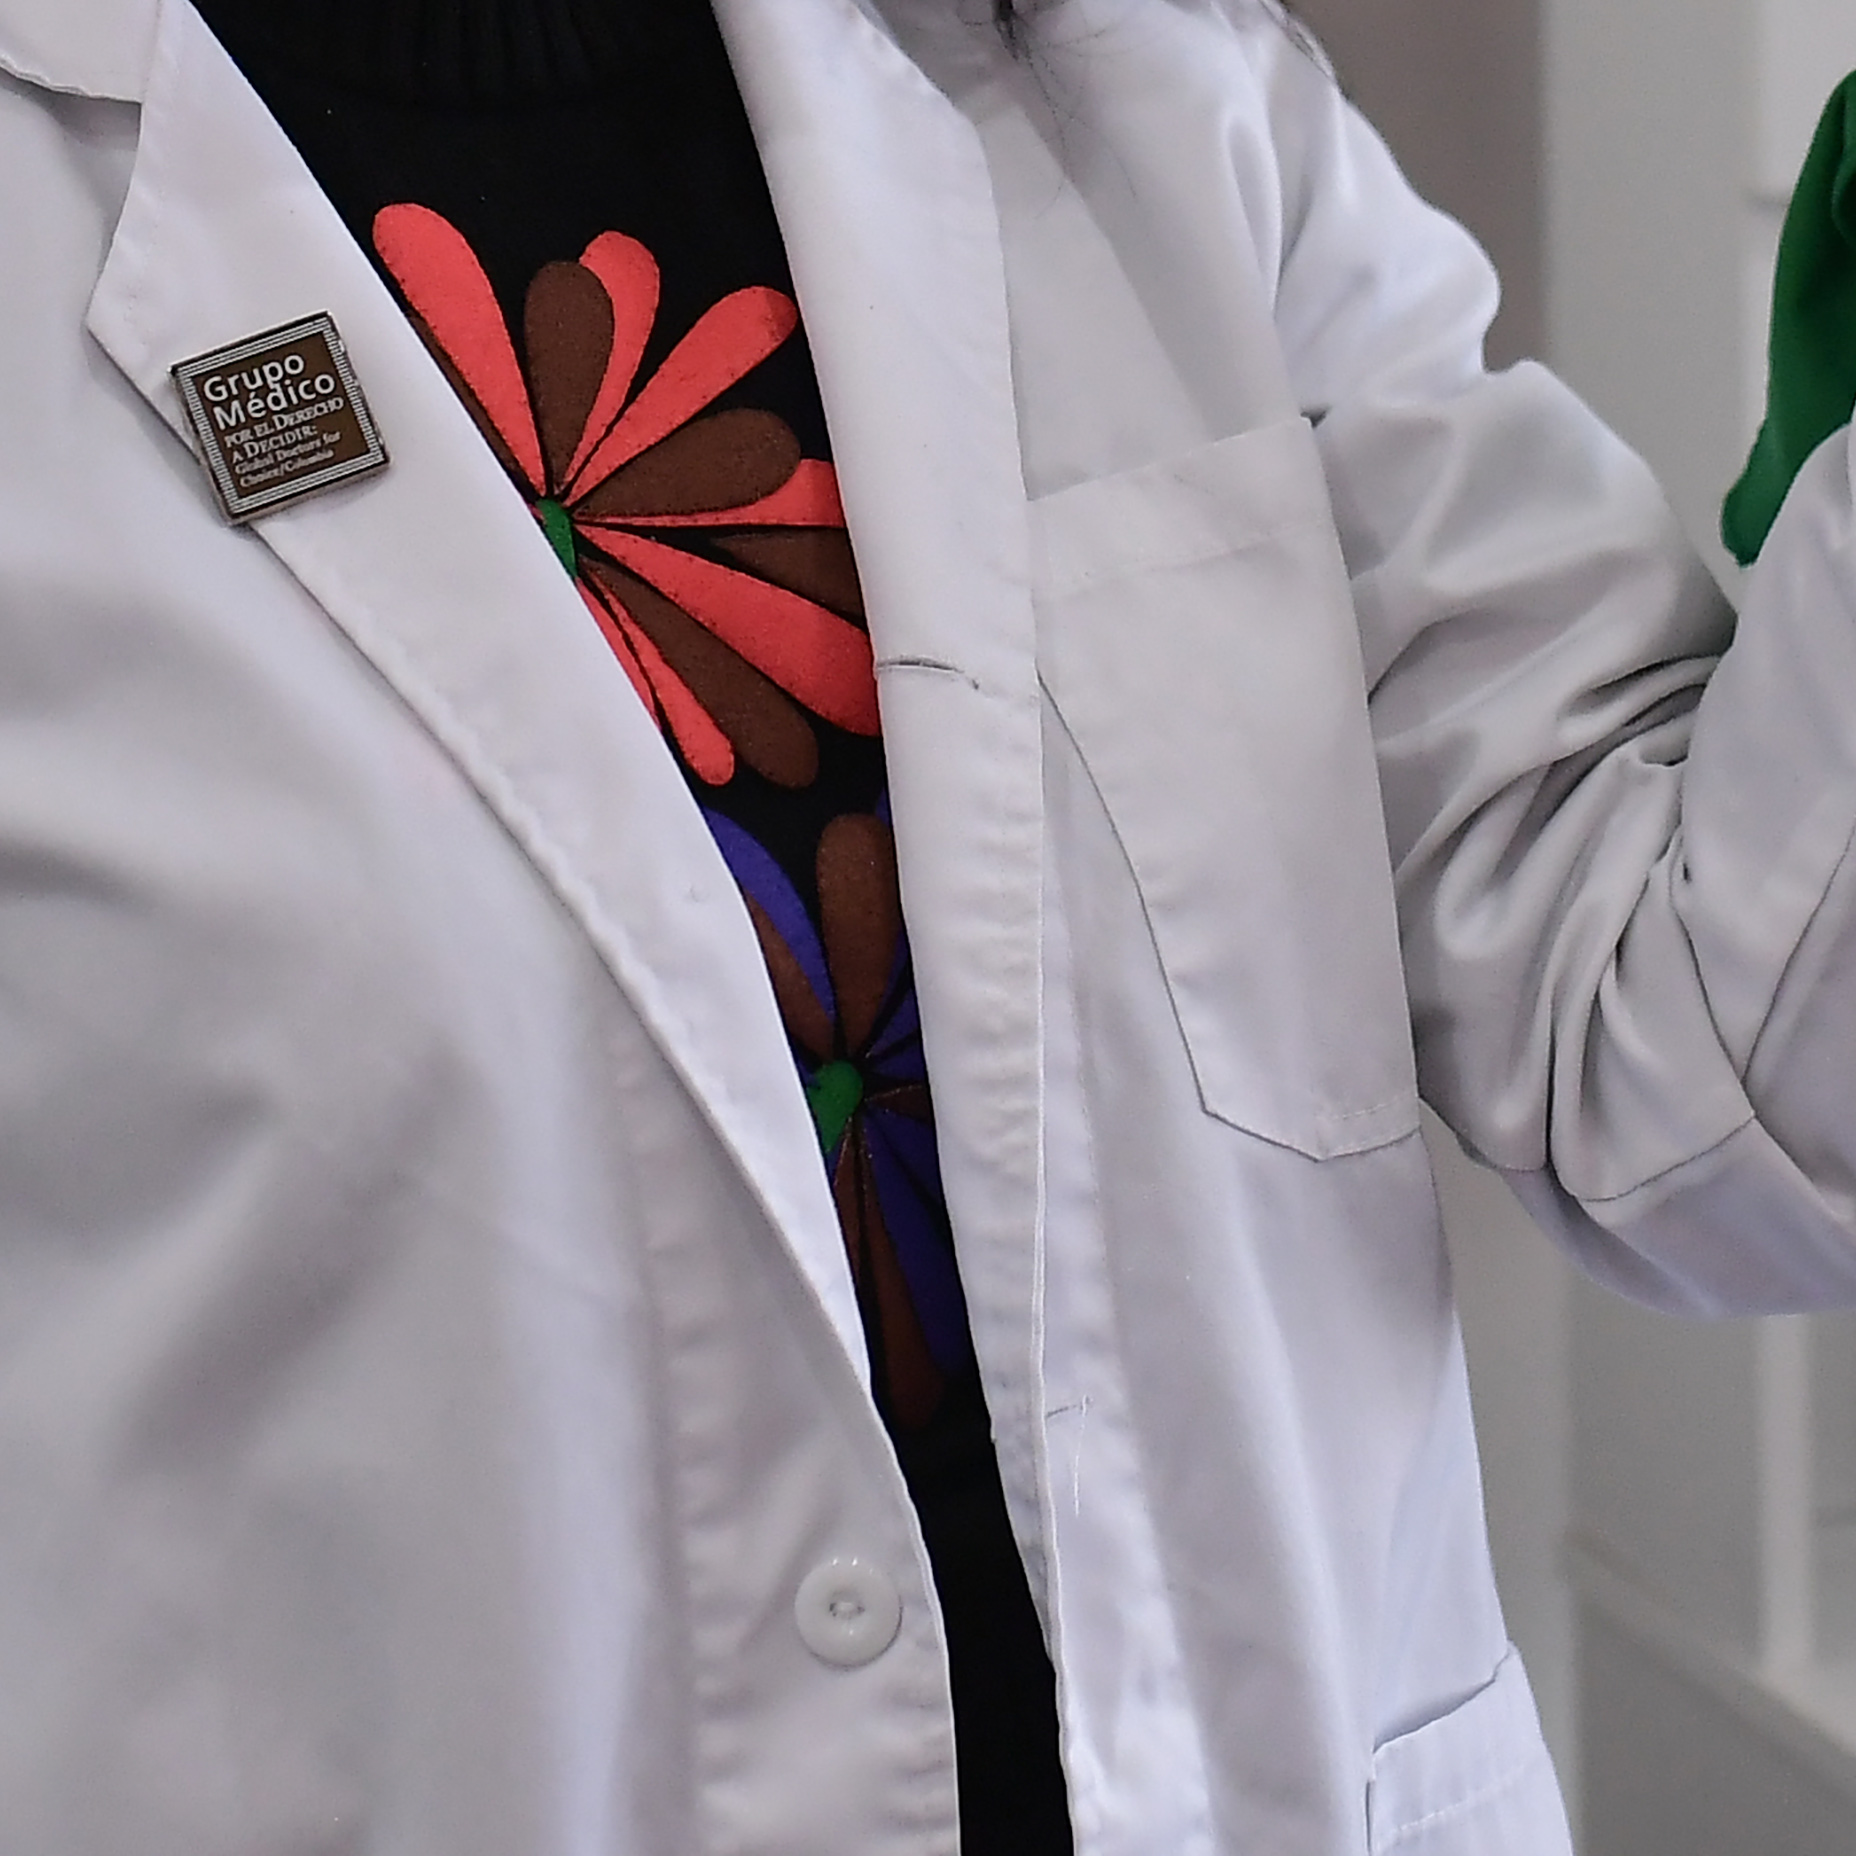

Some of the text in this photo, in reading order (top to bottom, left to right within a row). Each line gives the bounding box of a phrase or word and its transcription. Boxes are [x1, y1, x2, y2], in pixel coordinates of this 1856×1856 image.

[204, 355, 305, 401] Grupo
[213, 374, 335, 431] Médico
[254, 422, 275, 438] EL
